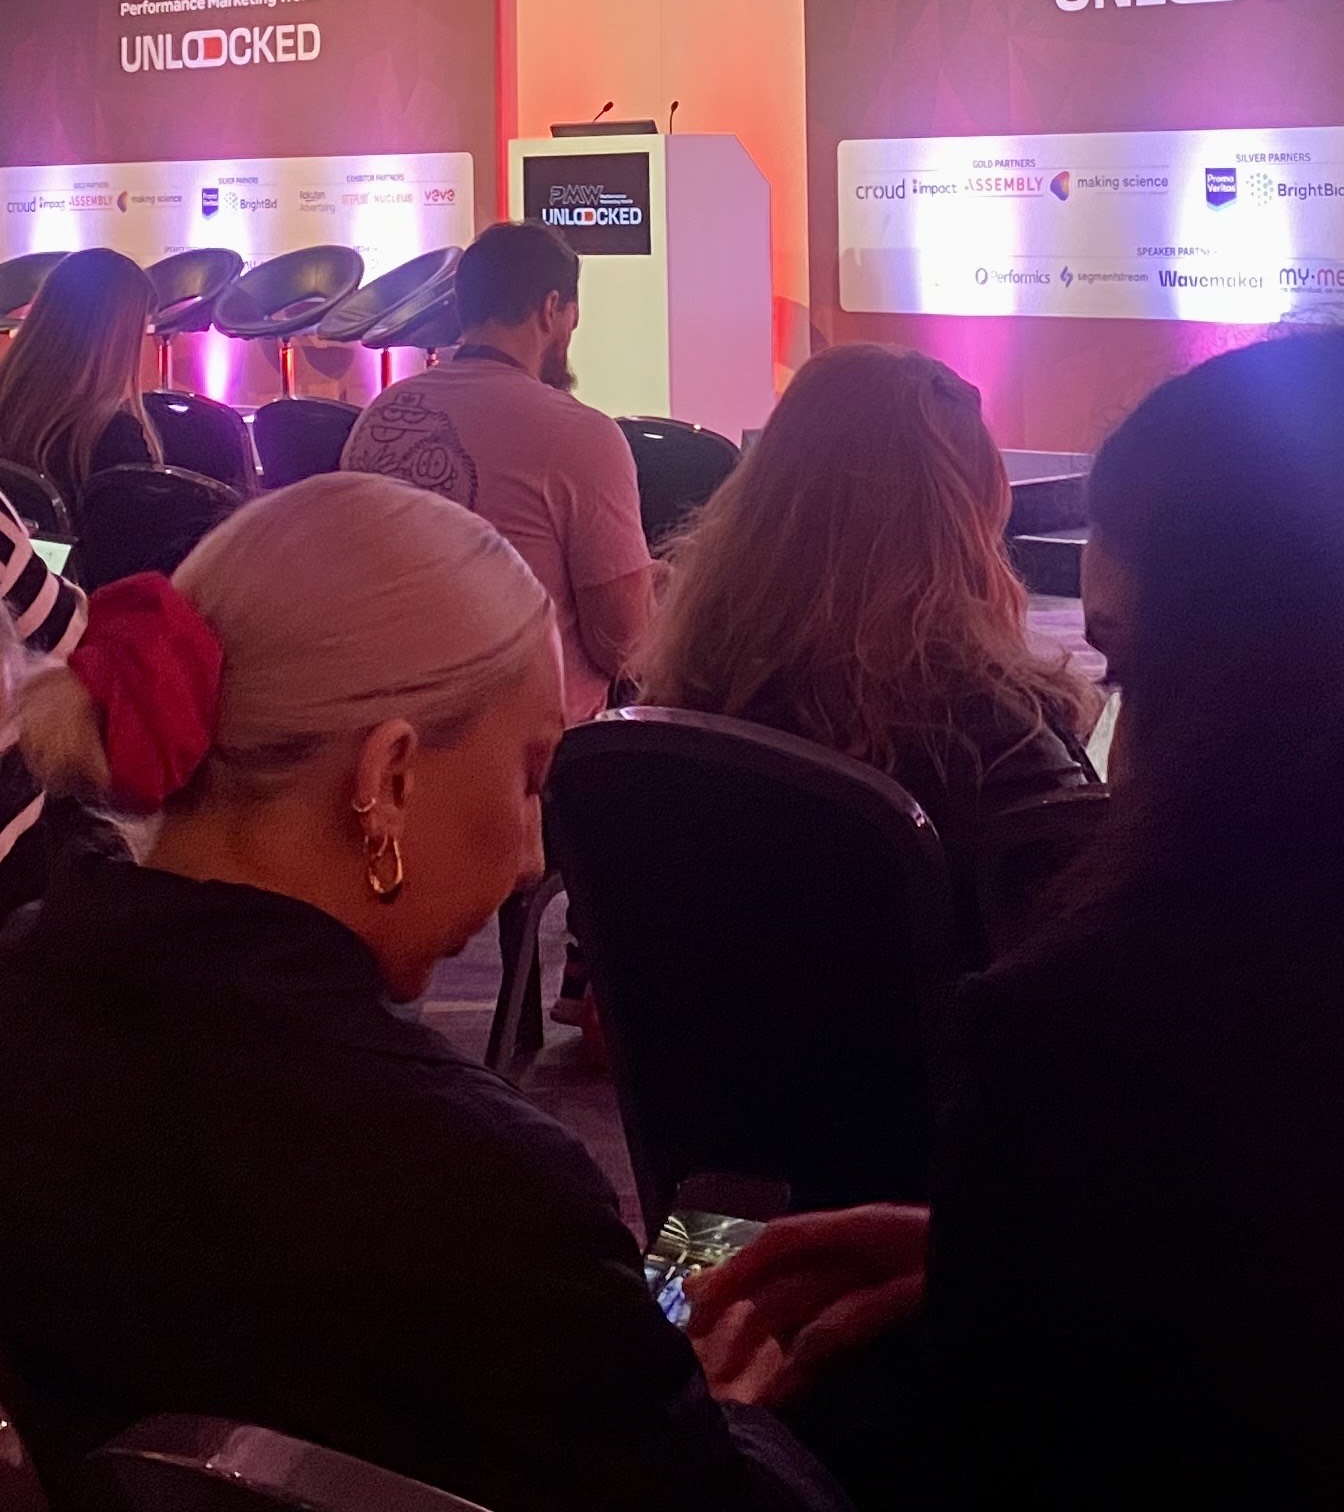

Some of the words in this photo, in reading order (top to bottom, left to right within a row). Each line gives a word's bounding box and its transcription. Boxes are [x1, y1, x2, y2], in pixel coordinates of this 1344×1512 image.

[120, 23, 321, 73] UNLOCKED
[973, 159, 993, 169] GOLD
[995, 159, 1036, 168] PARTNERS
[1235, 153, 1266, 163] SILVER
[856, 179, 906, 200] croud
[965, 177, 1044, 192] ASSEMBLY
[1077, 174, 1119, 191] making
[1123, 173, 1169, 188] science
[549, 184, 604, 205] PMW
[240, 198, 277, 212] BrightBid
[1137, 247, 1176, 256] SPEAKER
